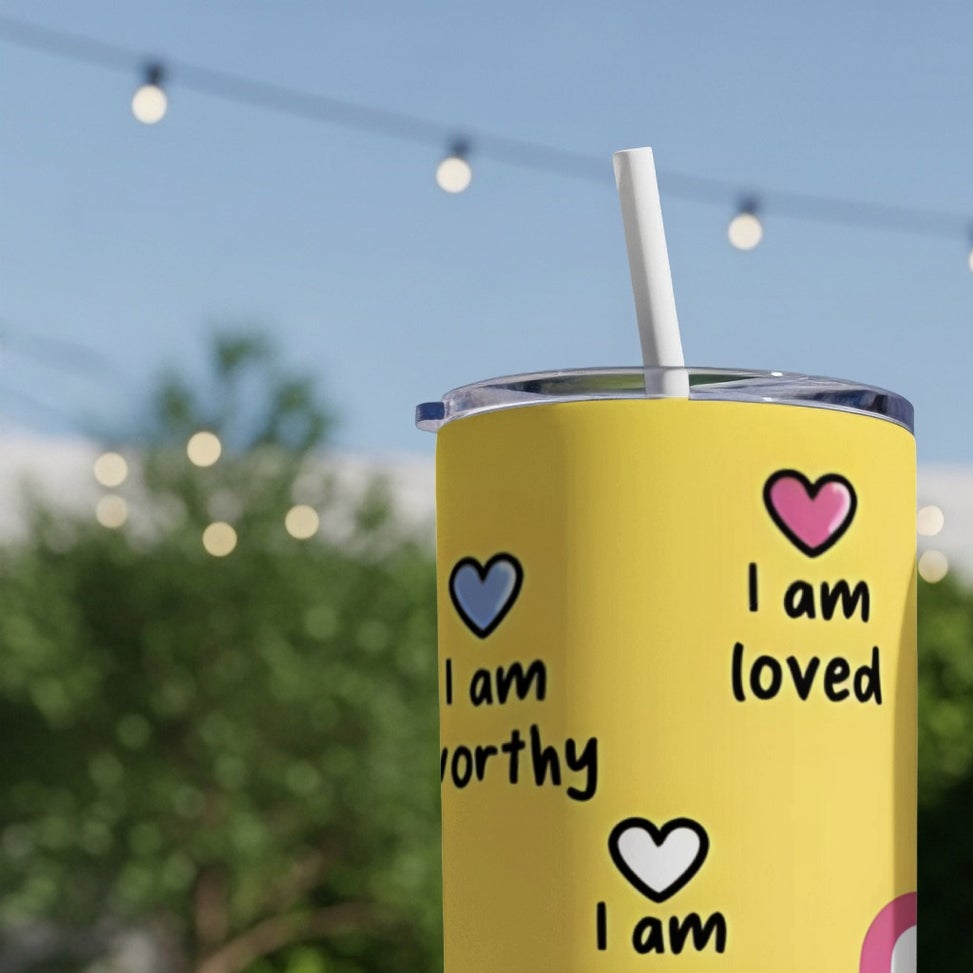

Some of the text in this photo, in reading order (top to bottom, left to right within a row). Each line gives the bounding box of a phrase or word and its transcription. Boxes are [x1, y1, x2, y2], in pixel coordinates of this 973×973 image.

[749, 563, 869, 623] I am
[446, 658, 547, 707] I am
[733, 642, 881, 705] loved
[597, 902, 727, 955] I am
